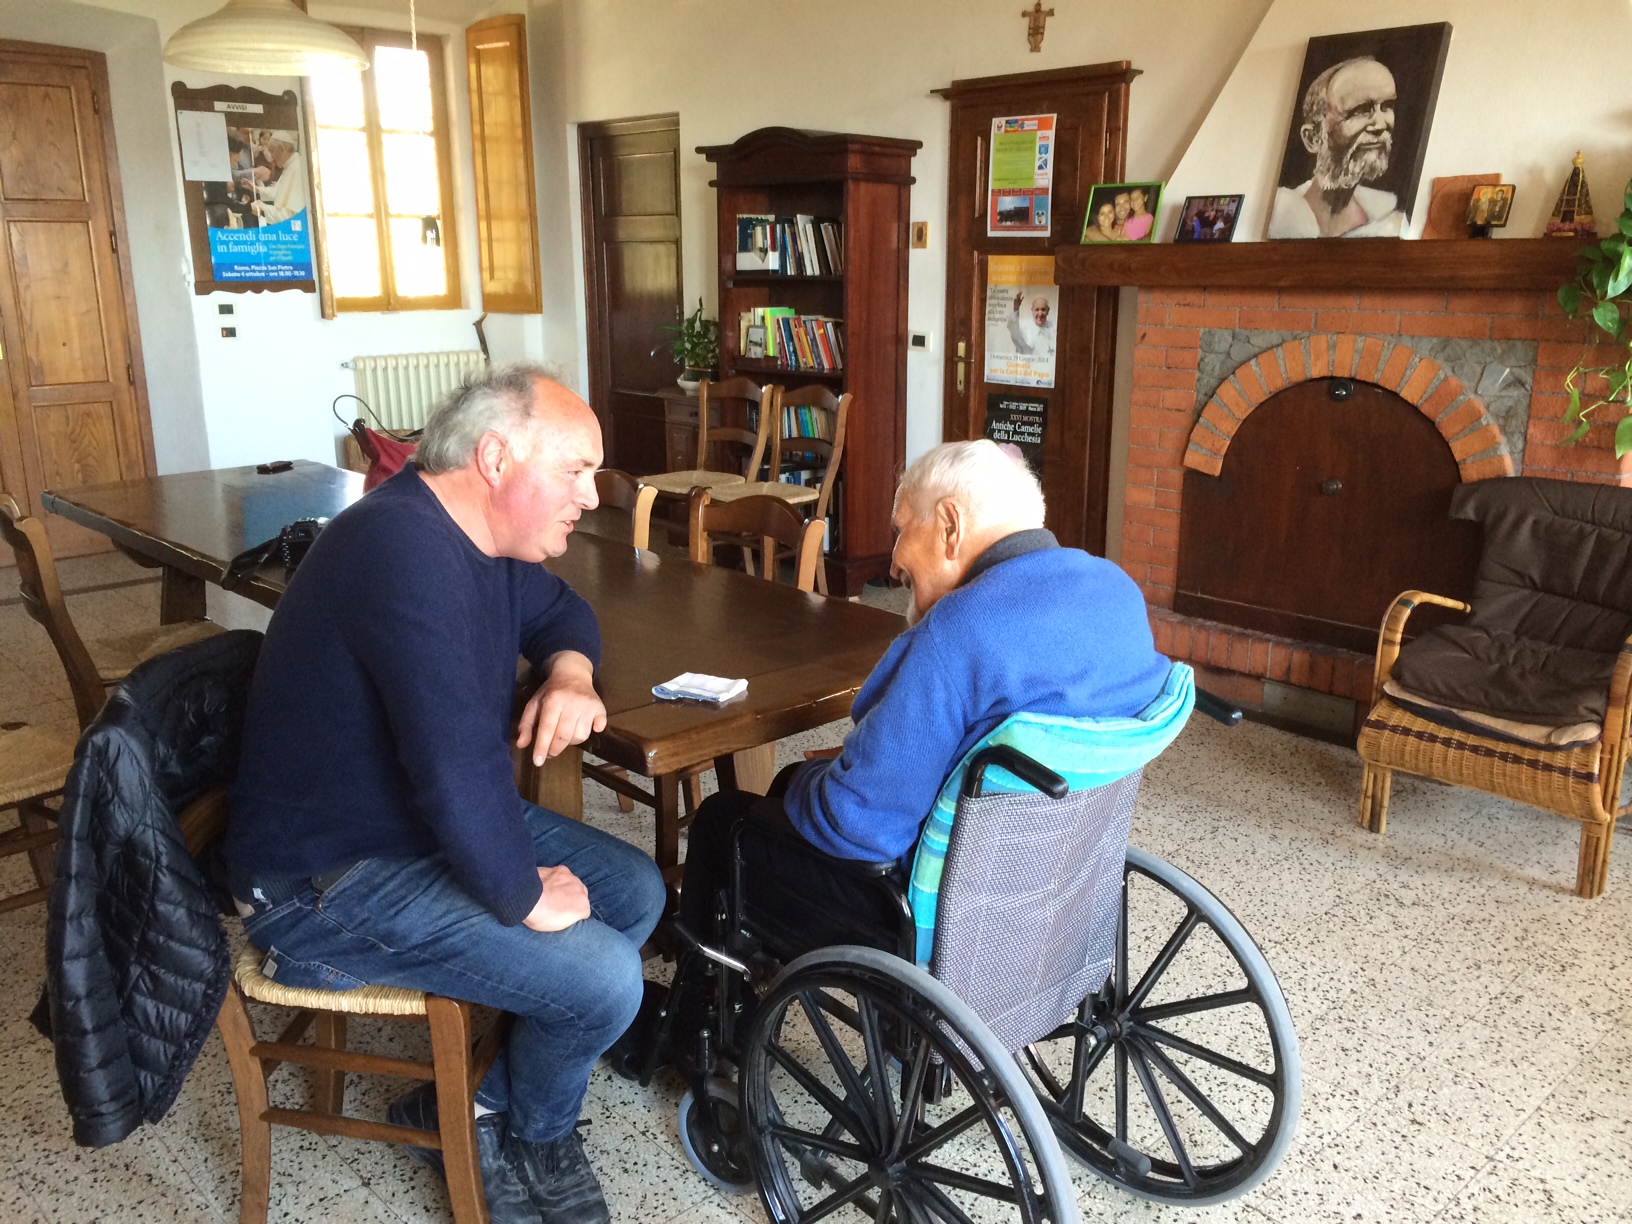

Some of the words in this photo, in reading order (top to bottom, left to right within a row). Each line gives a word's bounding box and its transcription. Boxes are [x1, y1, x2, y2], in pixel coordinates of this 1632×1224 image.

[215, 230, 256, 241] Accendi
[259, 233, 277, 241] una
[279, 231, 299, 241] luce
[217, 243, 228, 253] in
[229, 242, 268, 255] famiglia
[1033, 371, 1050, 379] Papa
[1022, 415, 1043, 423] MOSTRA
[991, 420, 1015, 431] Antiche
[1015, 422, 1043, 434] Camelie
[993, 430, 1008, 440] della
[1009, 431, 1041, 444] Lucchesia
